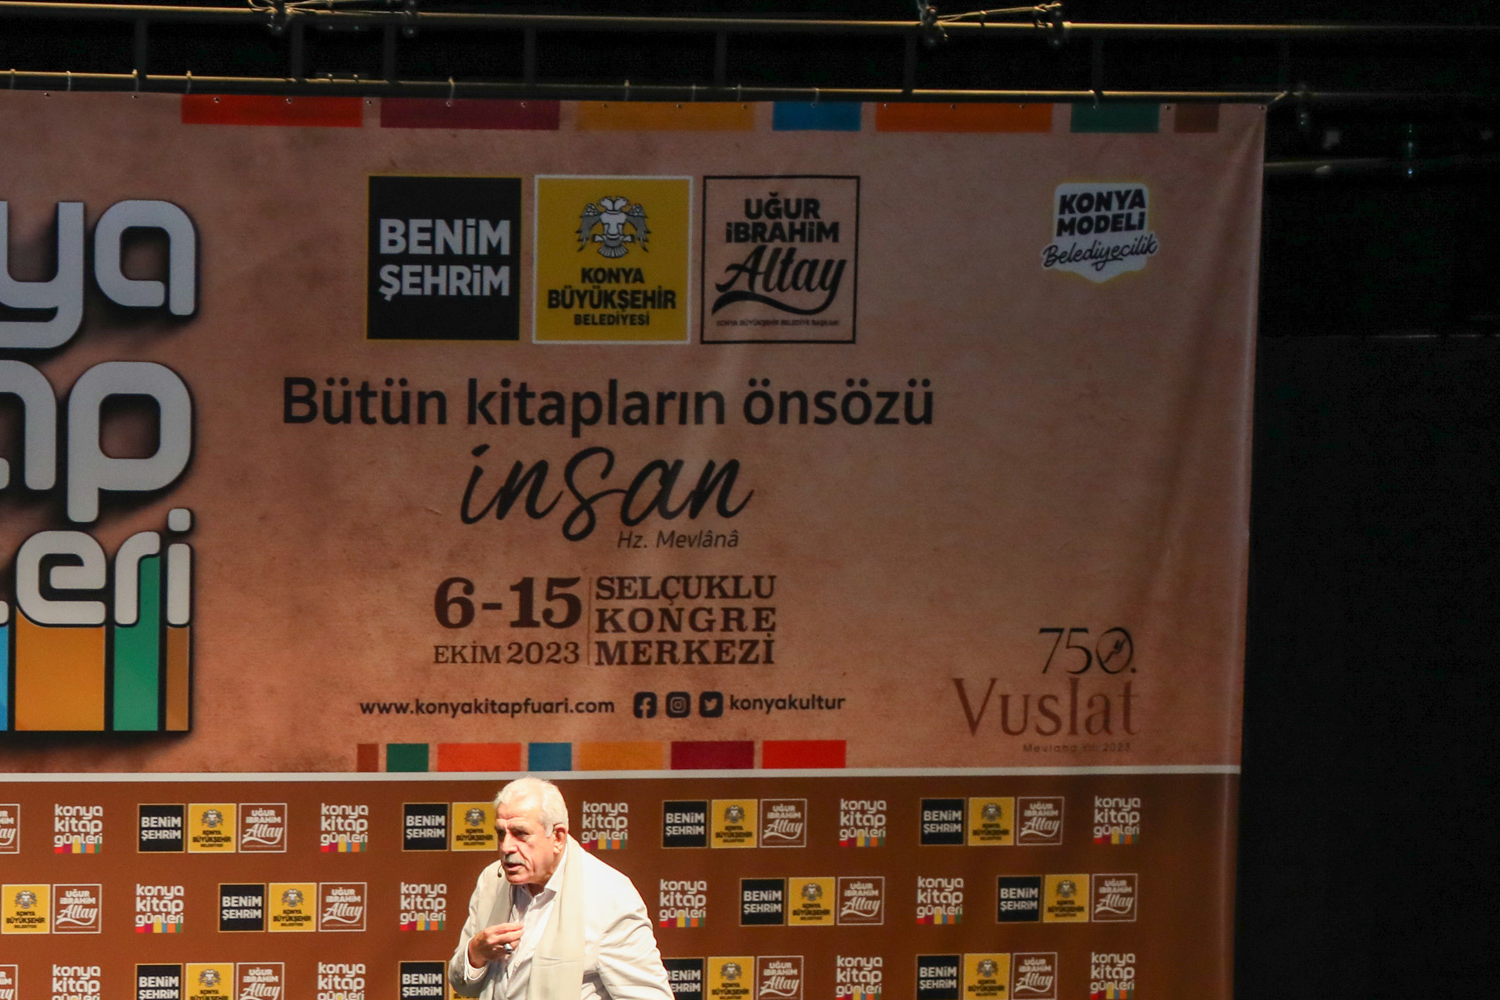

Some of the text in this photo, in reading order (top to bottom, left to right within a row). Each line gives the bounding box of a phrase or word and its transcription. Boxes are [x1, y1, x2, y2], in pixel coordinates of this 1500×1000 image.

[743, 192, 821, 220] UĞUR
[1058, 188, 1147, 215] KONYA
[1042, 233, 1158, 272] Belediyecilik
[580, 267, 645, 285] KONYA
[711, 244, 847, 315] Altay
[547, 285, 677, 313] BÜYÜKŞEHİR
[573, 312, 650, 327] BELEDİYESİ
[282, 376, 935, 438] Bütün kitapların önsözü
[459, 443, 756, 542] insan
[616, 529, 740, 549] Hz. Mevlânâ
[595, 574, 777, 606] SELÇUKLU
[433, 575, 583, 630] 6-15
[595, 606, 777, 634] KONGRE
[433, 640, 581, 665] EKİM 2023
[594, 633, 776, 666] MERKEZİ
[359, 697, 615, 719] www.konyakitapfuari.com
[729, 693, 846, 714] konyakultur
[951, 677, 1141, 737] Vuslat
[54, 804, 104, 820] konya
[582, 802, 628, 818] konya
[840, 799, 888, 815] konya
[54, 817, 104, 836] kitap
[582, 814, 628, 832] kitap
[840, 812, 888, 829] kitap
[54, 833, 104, 848] günleri
[582, 829, 628, 843] günleri
[840, 827, 888, 841] günleri
[134, 884, 184, 900] konya
[658, 879, 706, 895] konya
[851, 882, 875, 890] UĞUR
[916, 876, 964, 892] konya
[134, 897, 184, 915] kitap
[658, 891, 706, 909] kitap
[842, 896, 884, 915] Altay
[916, 889, 964, 906] kitap
[134, 913, 184, 927] günleri
[658, 906, 706, 920] günleri
[916, 904, 964, 918] günleri
[316, 962, 366, 978] konya
[836, 955, 884, 971] konya
[316, 975, 366, 993] kitap
[836, 968, 884, 985] kitap
[836, 983, 884, 997] günleri
